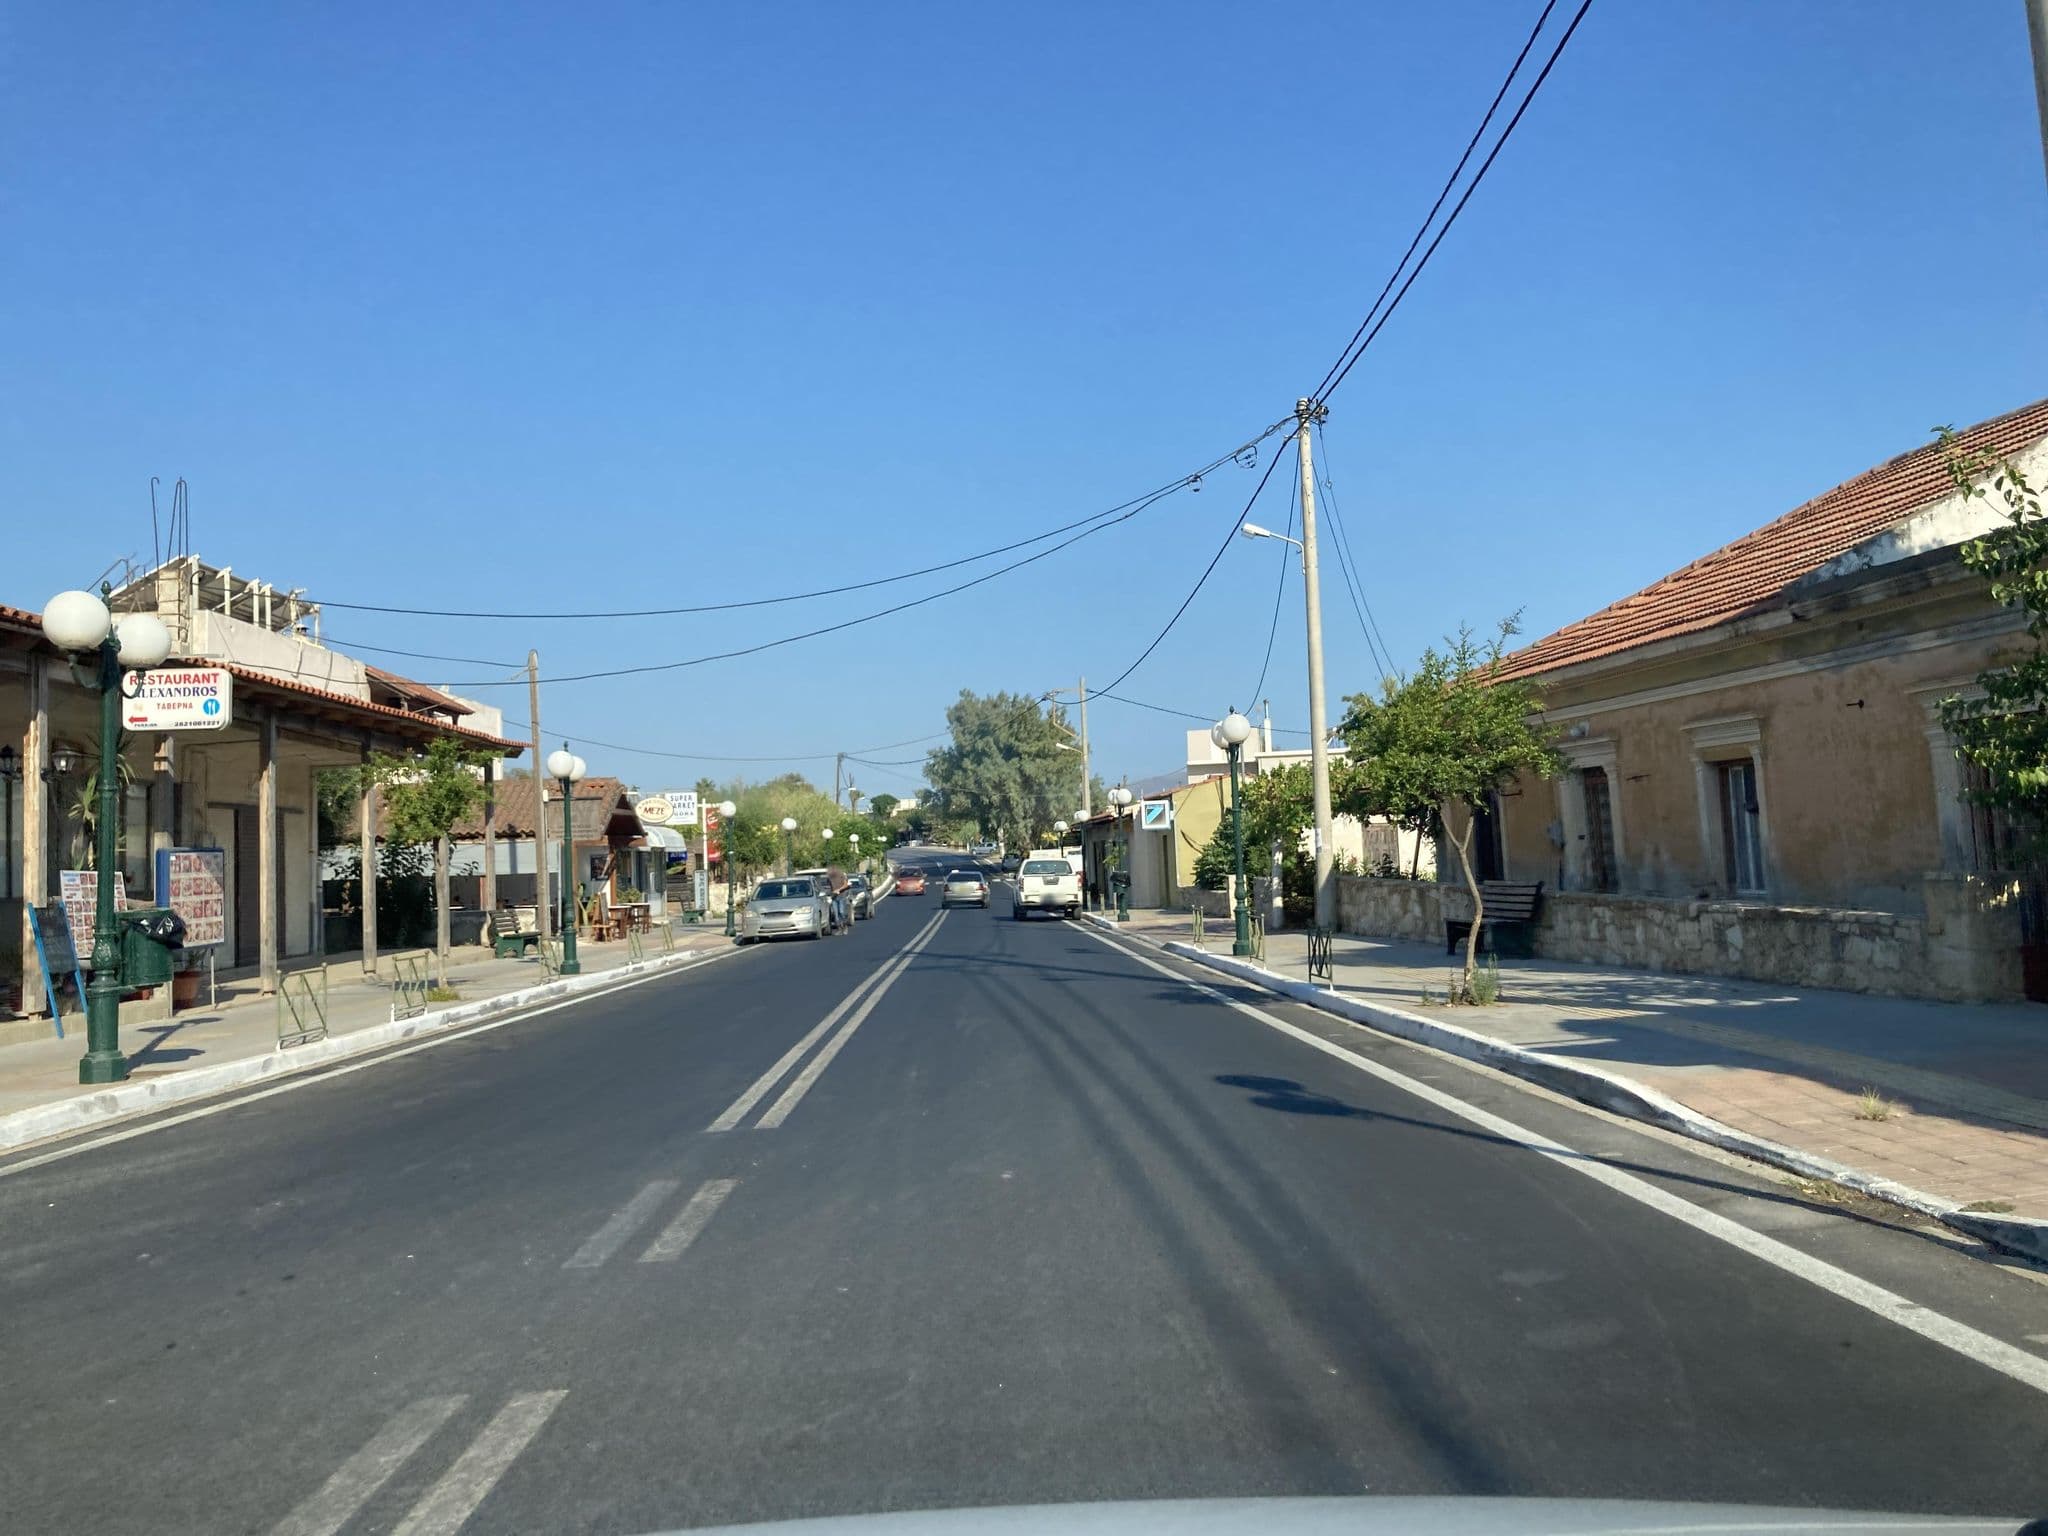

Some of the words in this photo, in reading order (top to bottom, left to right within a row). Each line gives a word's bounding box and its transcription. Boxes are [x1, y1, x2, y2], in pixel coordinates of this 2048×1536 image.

[136, 686, 217, 698] LEXANDROS
[670, 794, 693, 802] SUPER
[673, 801, 695, 809] ARKET
[643, 807, 665, 815] MEZE
